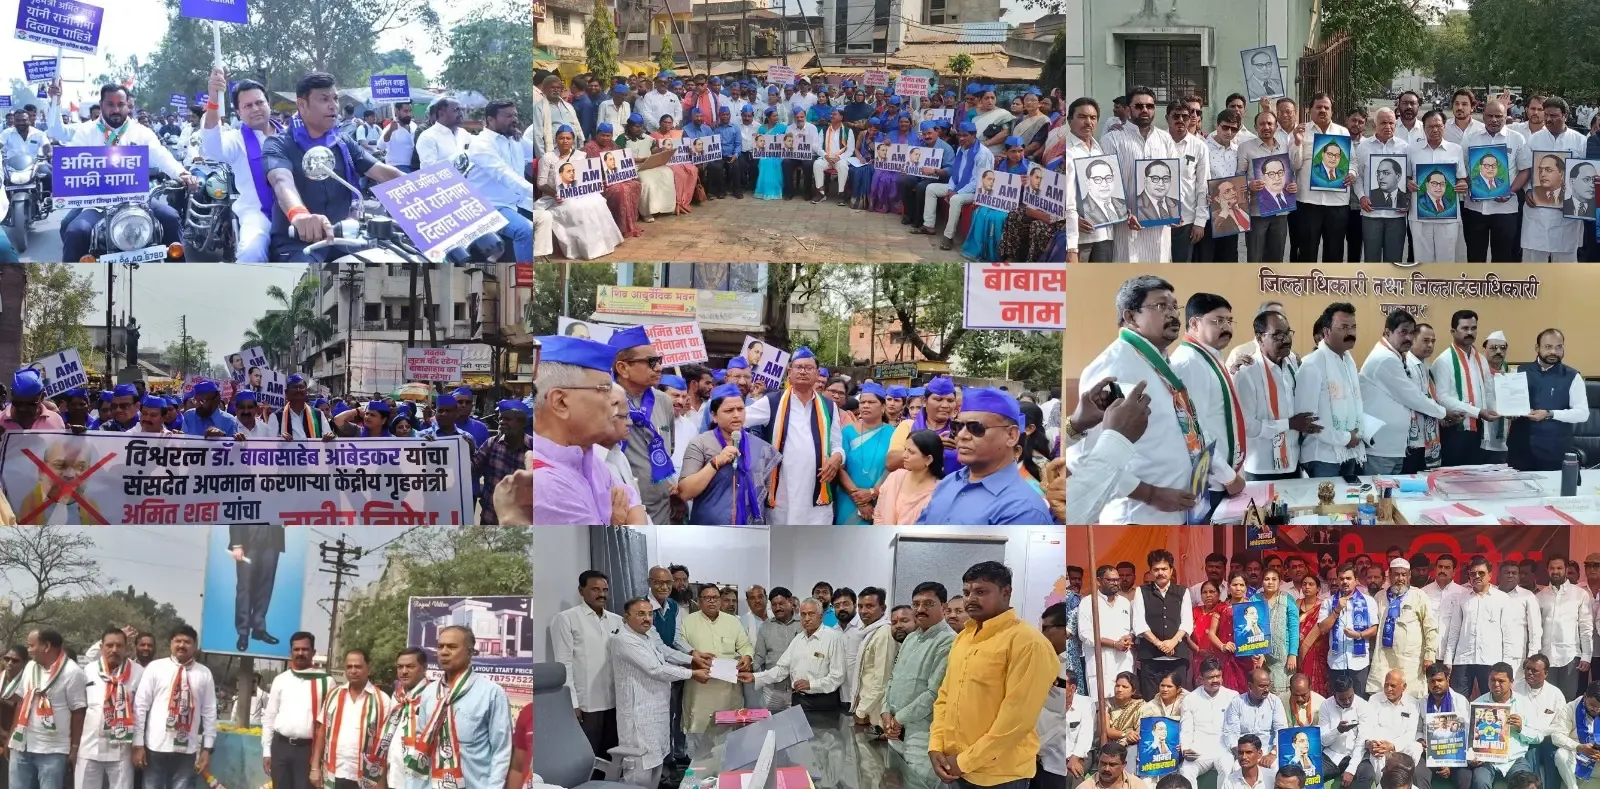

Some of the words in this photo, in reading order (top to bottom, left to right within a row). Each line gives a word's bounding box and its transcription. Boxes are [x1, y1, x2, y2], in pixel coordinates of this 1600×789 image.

[26, 6, 51, 20] यांनी
[25, 18, 61, 36] दिलाच
[62, 28, 93, 43] पाहिजे
[373, 78, 392, 87] अमित
[708, 143, 720, 152] AM
[769, 143, 782, 151] AM
[782, 151, 812, 160] AMBEDKAR
[61, 152, 107, 169] अमित
[110, 155, 141, 169] शहा
[620, 158, 634, 169] AM
[693, 152, 722, 164] AMBEDKAR
[891, 153, 906, 162] AM
[923, 158, 940, 167] AM
[64, 171, 101, 188] माफी
[104, 174, 139, 186] मागा.
[582, 169, 600, 182] AM
[607, 168, 638, 184] AMBEDKAR
[385, 180, 418, 204] गृहमंत्री
[560, 182, 604, 199] AMBEDKAR
[998, 185, 1019, 199] AM
[1045, 185, 1064, 202] AM
[400, 197, 432, 220] यांनी
[425, 182, 470, 209] राजीनामा
[975, 193, 1018, 211] AMBEDKAR
[1024, 192, 1064, 217] AMBEDKAR
[416, 212, 459, 244] दिलाच
[453, 197, 487, 222] पाहिजे
[1259, 266, 1368, 296] जिल्हाधिकारी
[1371, 277, 1407, 297] तथा
[1410, 271, 1540, 299] जिल्हादंडाधिकारी
[675, 292, 696, 302] भवन
[999, 301, 1064, 324] नाम
[674, 324, 694, 336] शहा
[56, 361, 78, 378] AM
[249, 356, 265, 367] AM
[763, 361, 783, 378] AM
[266, 382, 284, 395] AM
[125, 440, 209, 467] विश्वरत्न
[211, 443, 235, 467] डॉ.
[240, 443, 320, 467] बाबासाहेब
[324, 443, 402, 466] आंबेडकर
[404, 443, 449, 466] यांचा
[122, 469, 190, 496] संसदेत
[192, 474, 256, 494] अपमान
[333, 468, 381, 493] केंद्रीय
[384, 467, 449, 501] गृहमंत्री
[121, 498, 180, 525] अमित
[183, 502, 221, 523] शहा
[223, 496, 262, 520] यांचा
